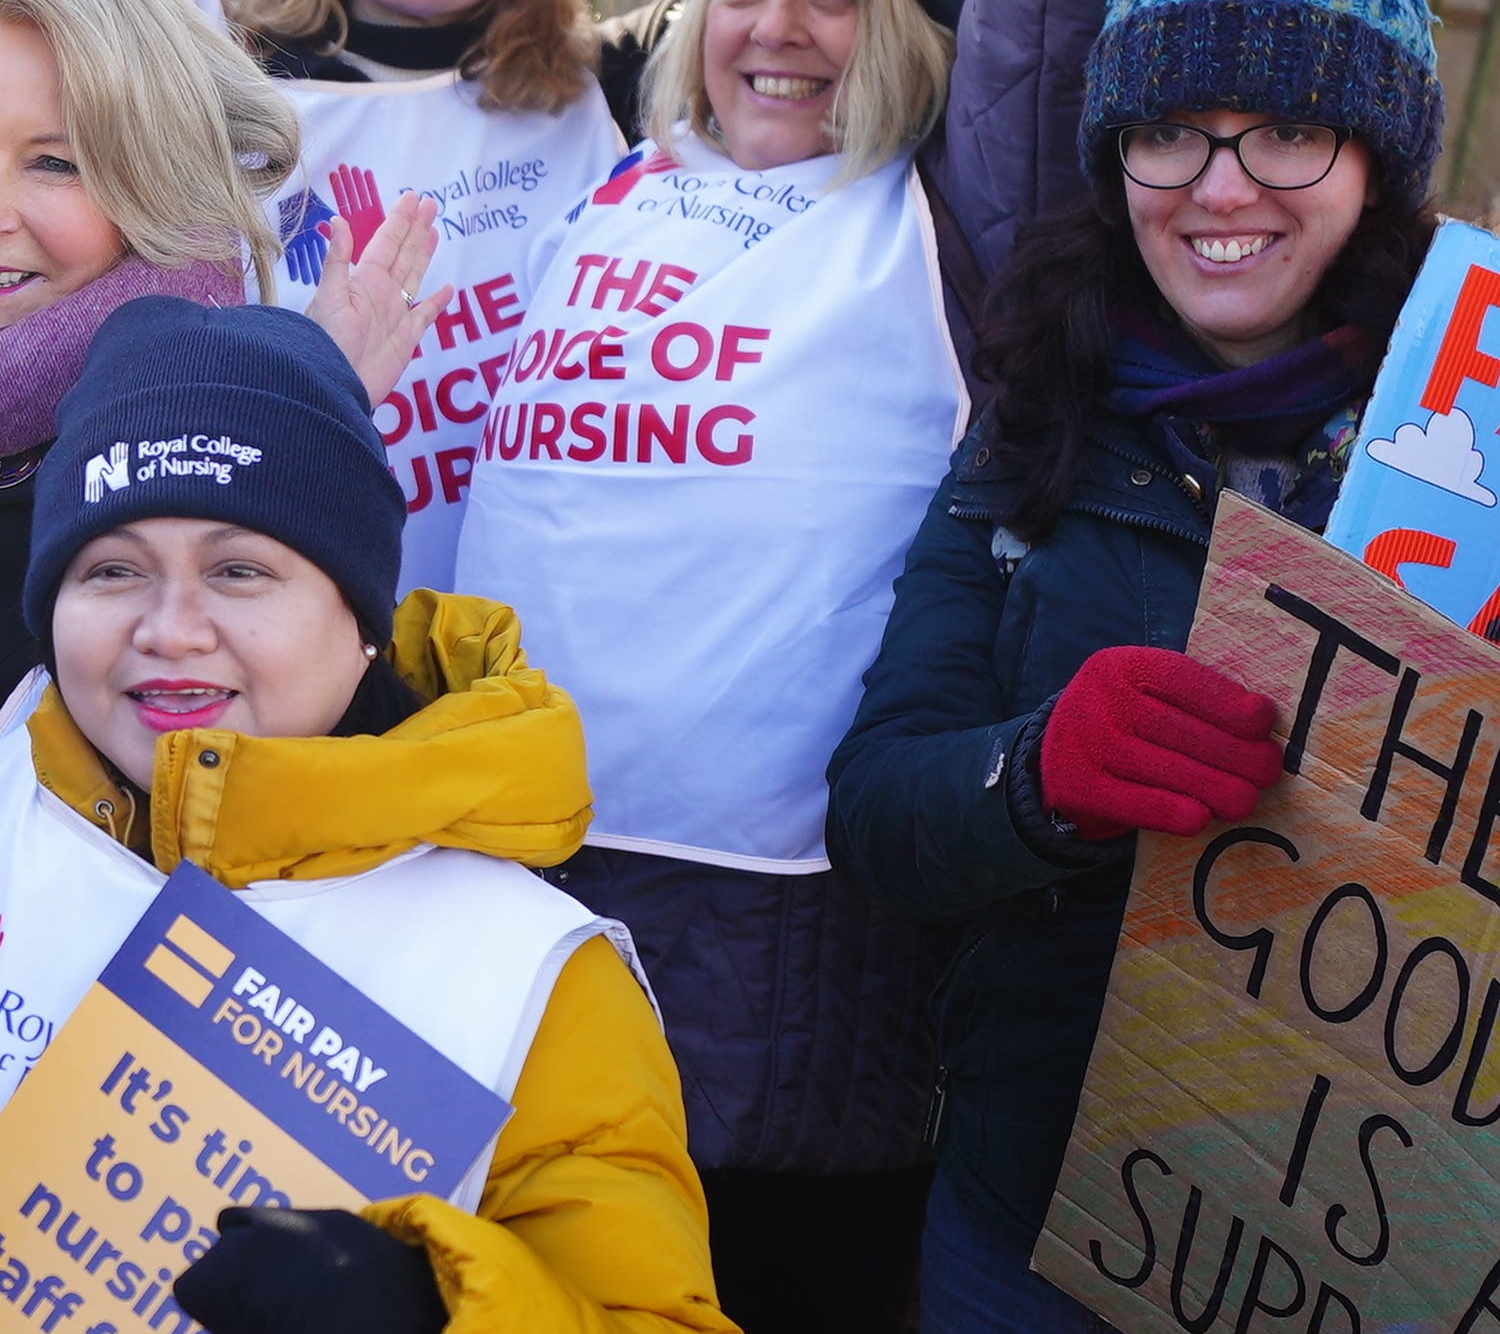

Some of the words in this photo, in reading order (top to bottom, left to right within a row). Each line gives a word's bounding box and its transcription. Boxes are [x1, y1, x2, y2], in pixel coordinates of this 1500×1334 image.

[474, 156, 550, 195] College
[442, 199, 528, 242] Nursing
[665, 195, 774, 250] Nursing
[411, 273, 527, 361] HE
[565, 254, 699, 318] THE
[650, 321, 771, 382] OF
[138, 435, 188, 460] Royal
[191, 435, 263, 466] College
[476, 402, 757, 467] NURSING
[137, 458, 157, 482] of
[161, 457, 233, 484] Nursing
[231, 965, 318, 1047] FAIR
[309, 1023, 390, 1095] PAY
[211, 998, 278, 1067] FOR
[279, 1051, 437, 1185] NURSING
[95, 1049, 192, 1144] It's
[194, 1126, 295, 1210] tim
[1279, 1072, 1413, 1267] IS
[83, 1132, 146, 1203] to
[141, 1194, 225, 1275] pa
